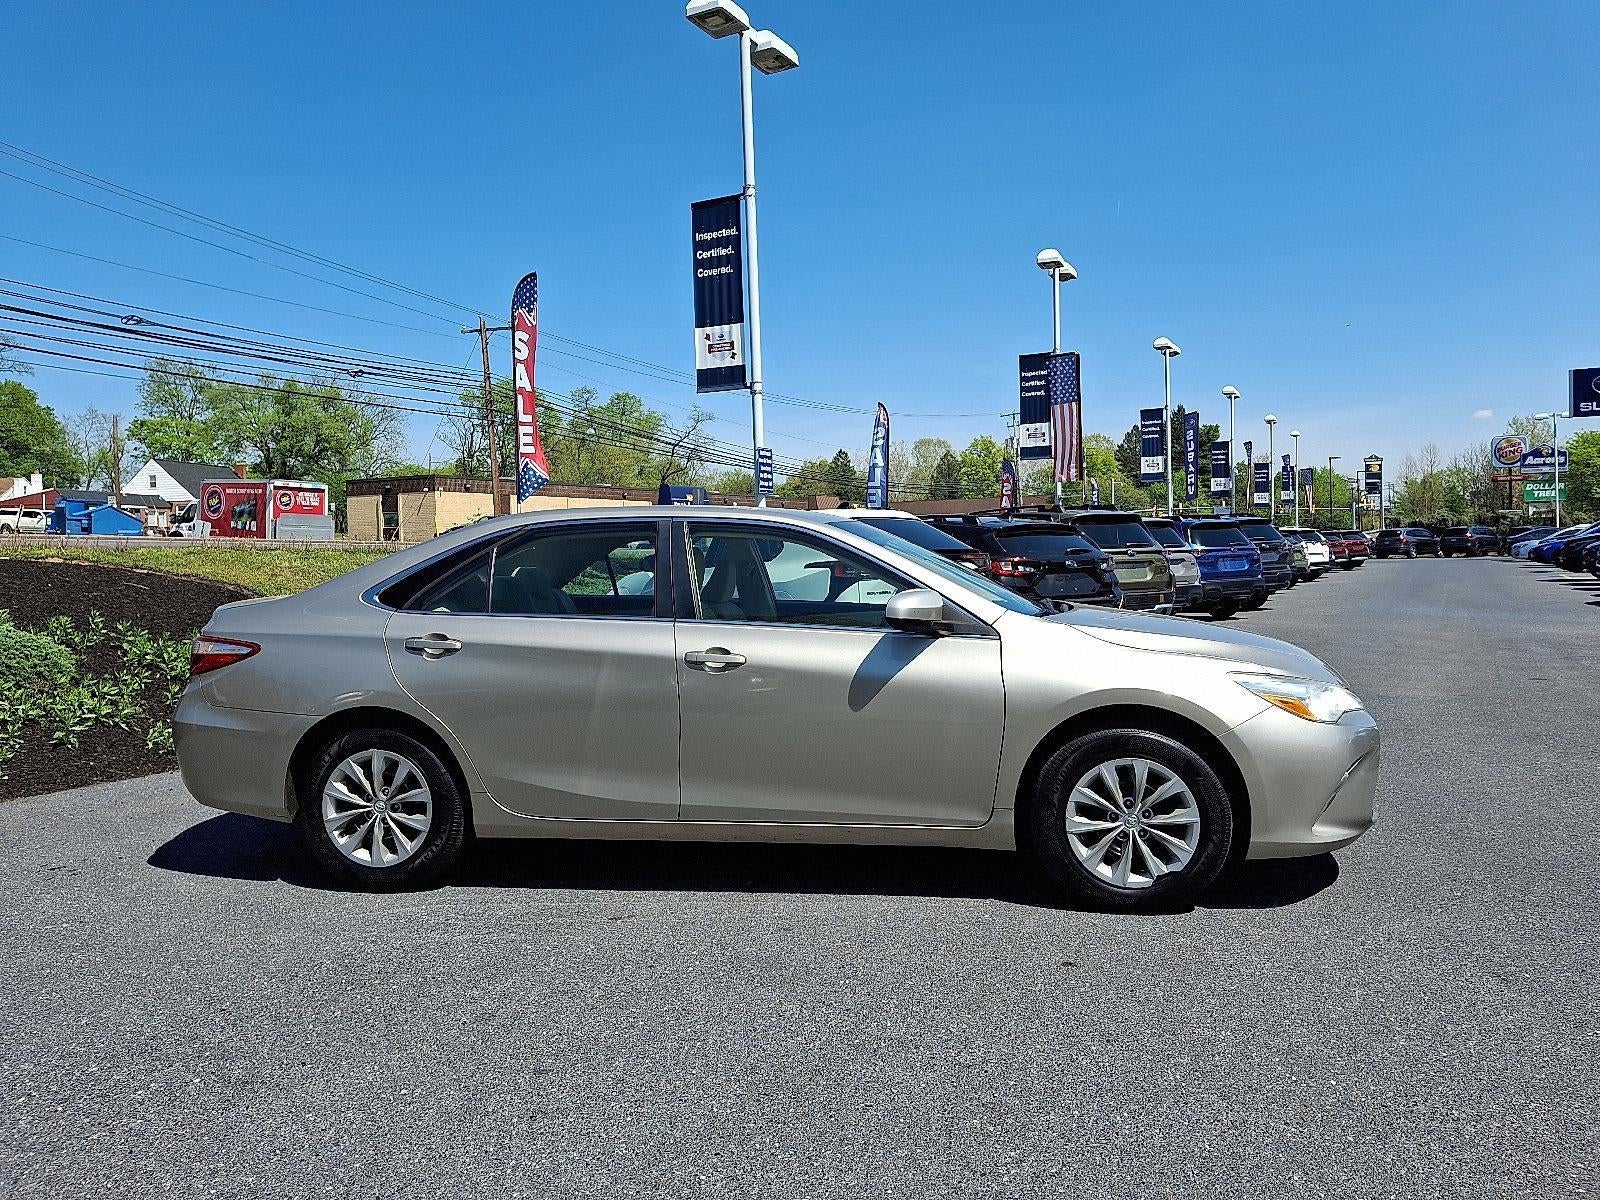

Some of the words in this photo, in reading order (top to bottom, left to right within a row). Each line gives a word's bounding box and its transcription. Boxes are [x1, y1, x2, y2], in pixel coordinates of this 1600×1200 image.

[696, 226, 738, 242] Inspected.
[697, 245, 734, 260] Certified.
[697, 264, 734, 278] Covered.
[514, 330, 536, 454] SALE
[1497, 441, 1522, 453] BURGER
[1498, 447, 1523, 459] KING
